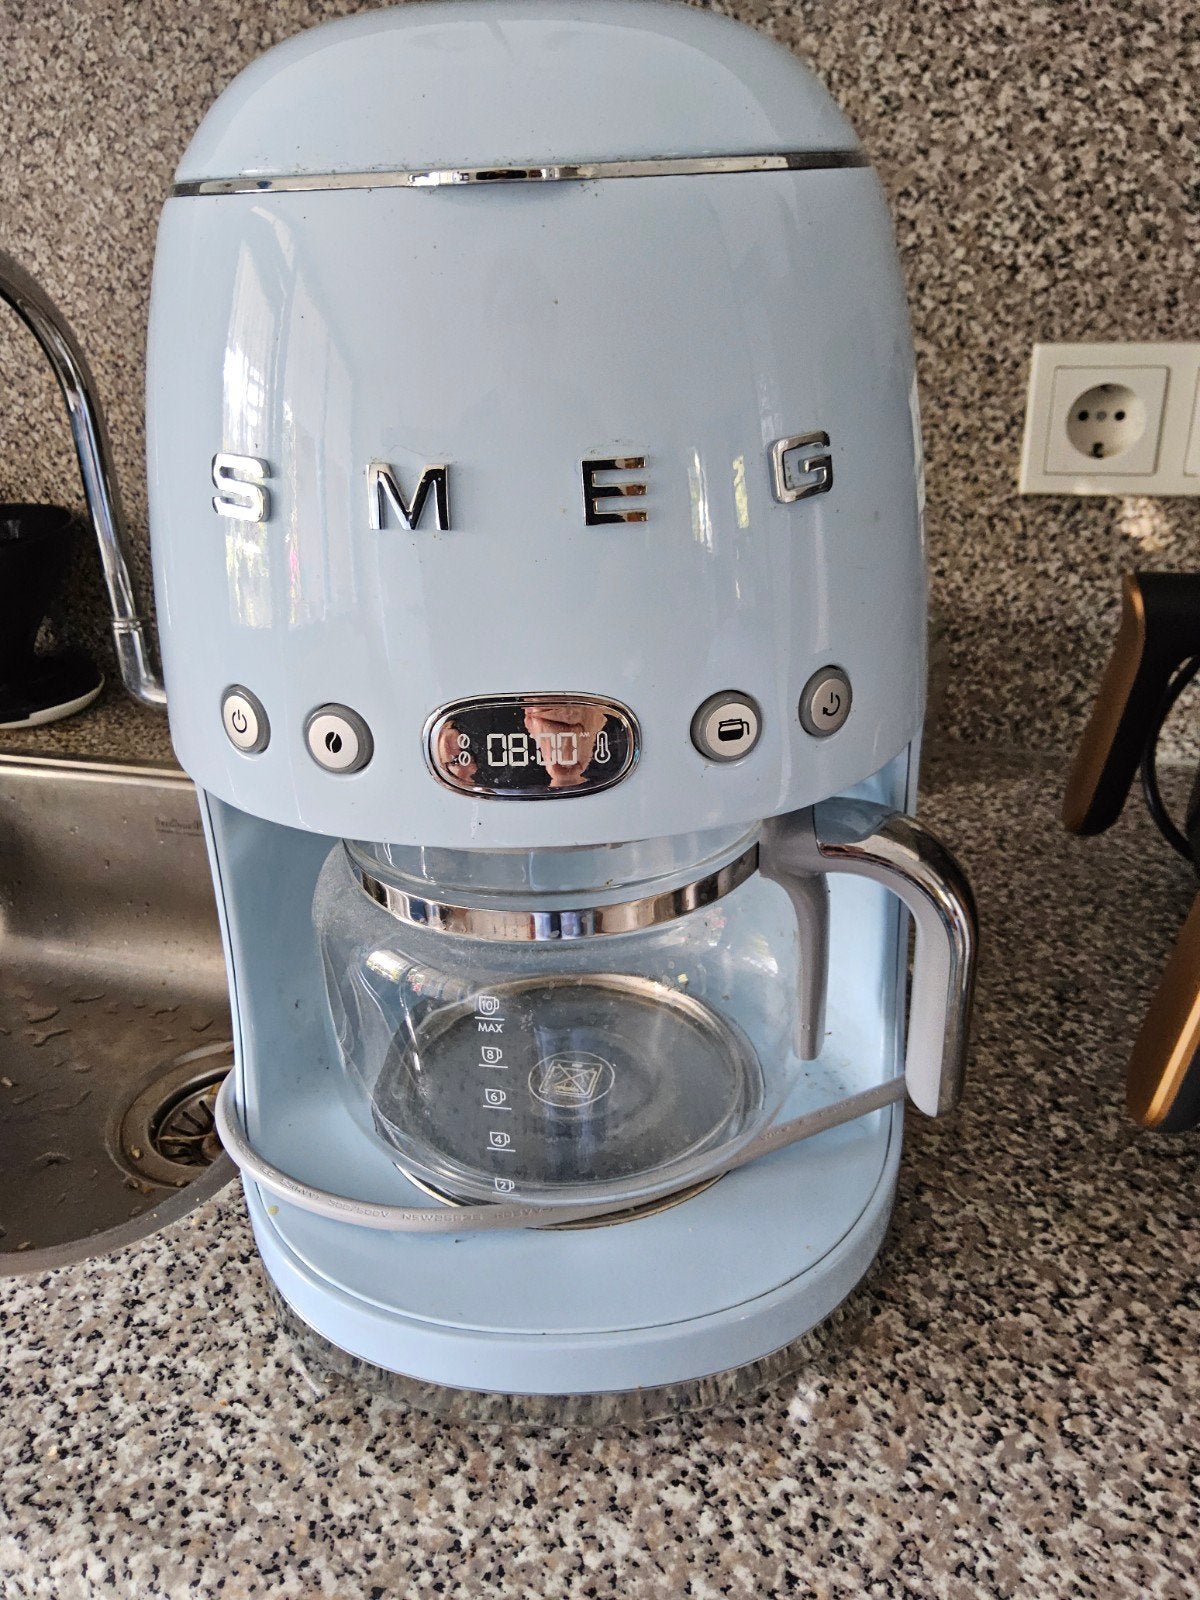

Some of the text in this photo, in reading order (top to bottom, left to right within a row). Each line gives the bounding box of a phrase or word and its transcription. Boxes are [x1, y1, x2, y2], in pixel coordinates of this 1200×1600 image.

[211, 430, 835, 531] SMEG
[482, 1000, 493, 1011] 10
[477, 1023, 503, 1034] MAX
[486, 1050, 495, 1060] 8
[490, 1092, 498, 1102] 6
[493, 1135, 502, 1144] 4
[499, 1181, 507, 1190] 2
